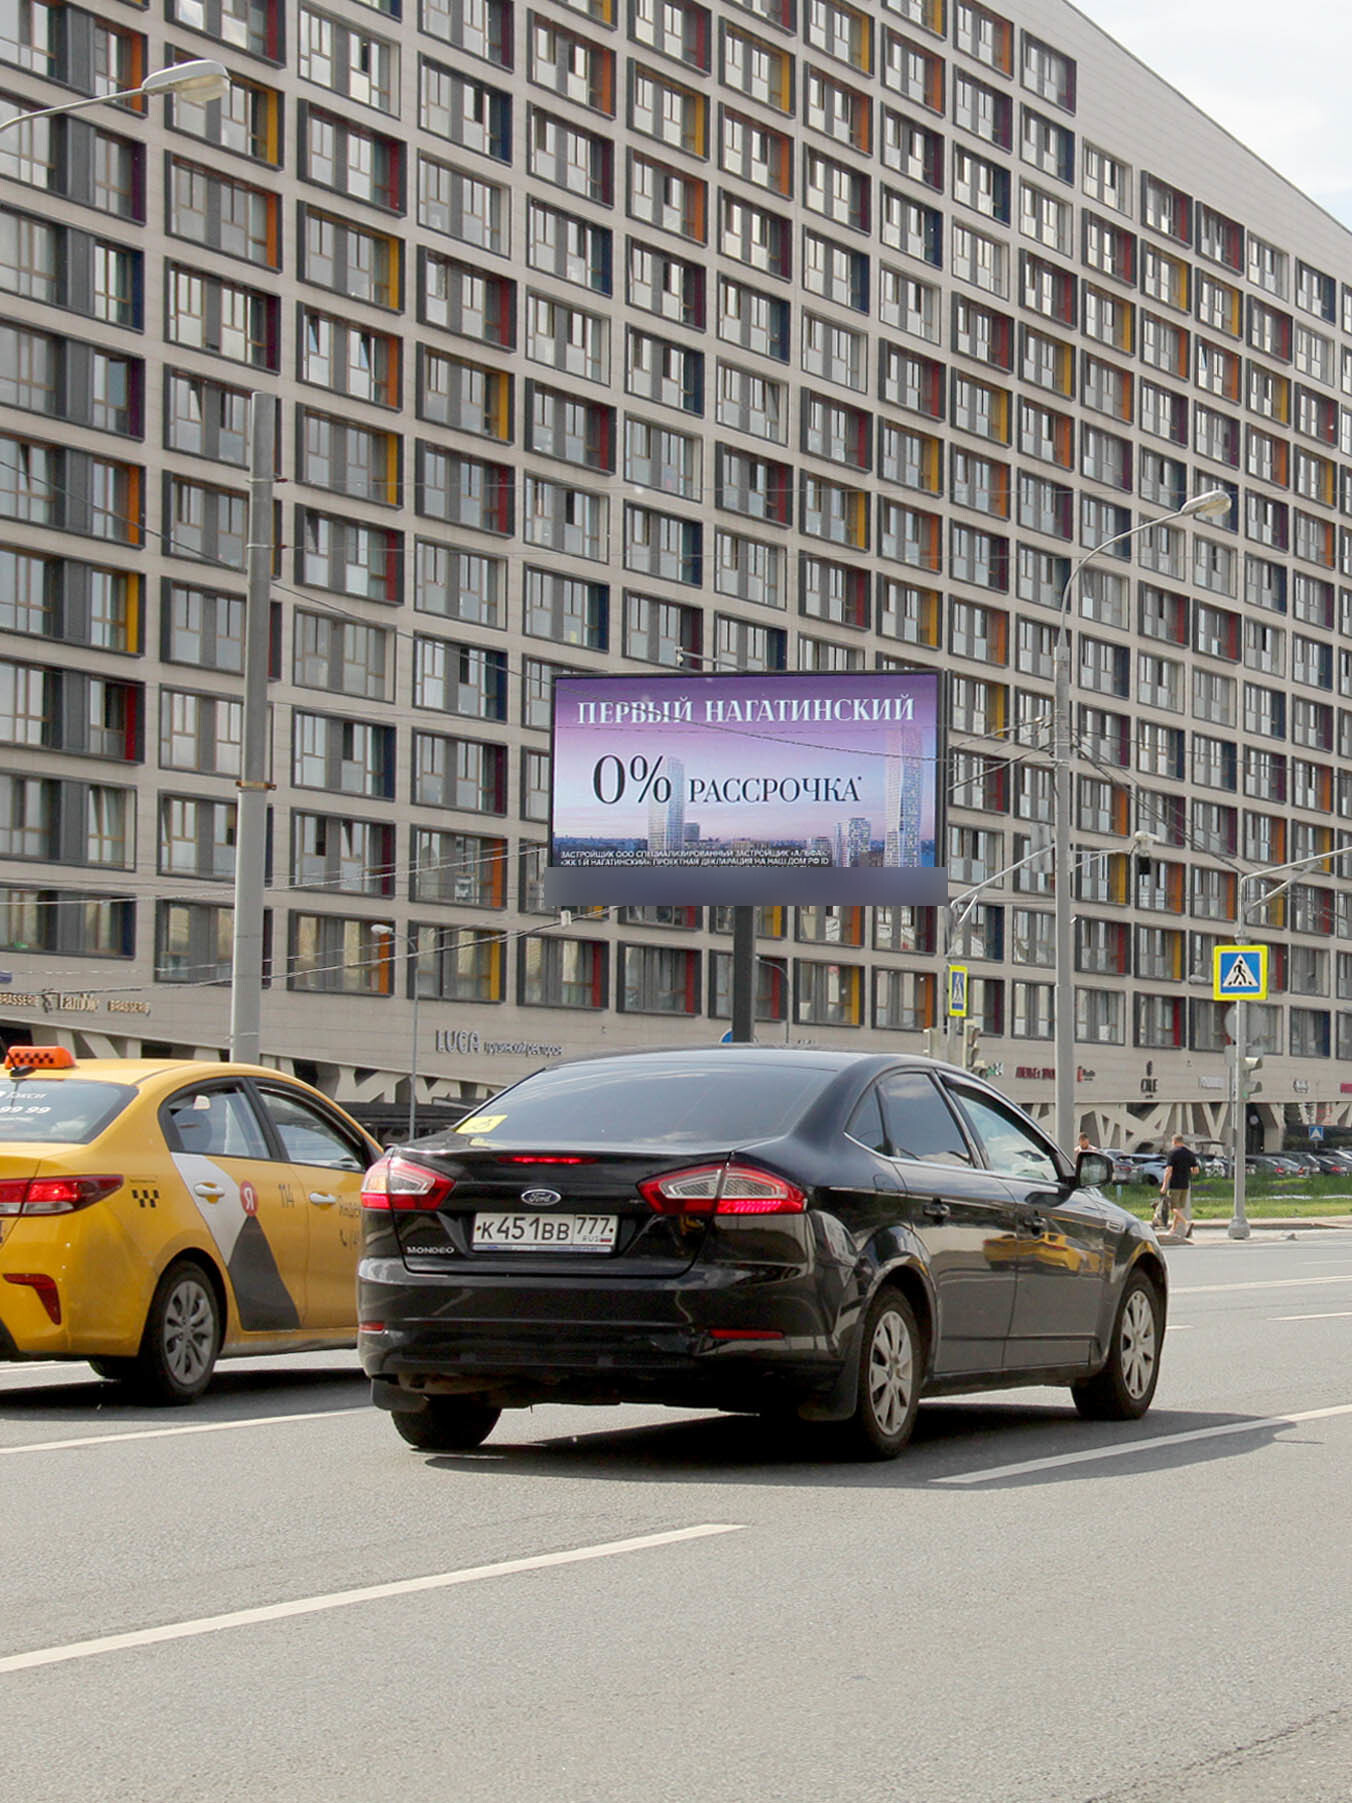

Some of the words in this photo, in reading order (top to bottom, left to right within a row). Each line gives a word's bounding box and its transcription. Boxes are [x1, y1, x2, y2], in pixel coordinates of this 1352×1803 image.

[577, 696, 694, 724] ПЕРВЫЙ
[705, 693, 916, 722] НАГАТИНСКИЙ
[593, 754, 672, 805] 0%
[615, 850, 635, 858] ООО
[481, 1216, 570, 1241] К451ВВ
[576, 1217, 611, 1235] 777
[406, 1246, 455, 1254] MONDEO
